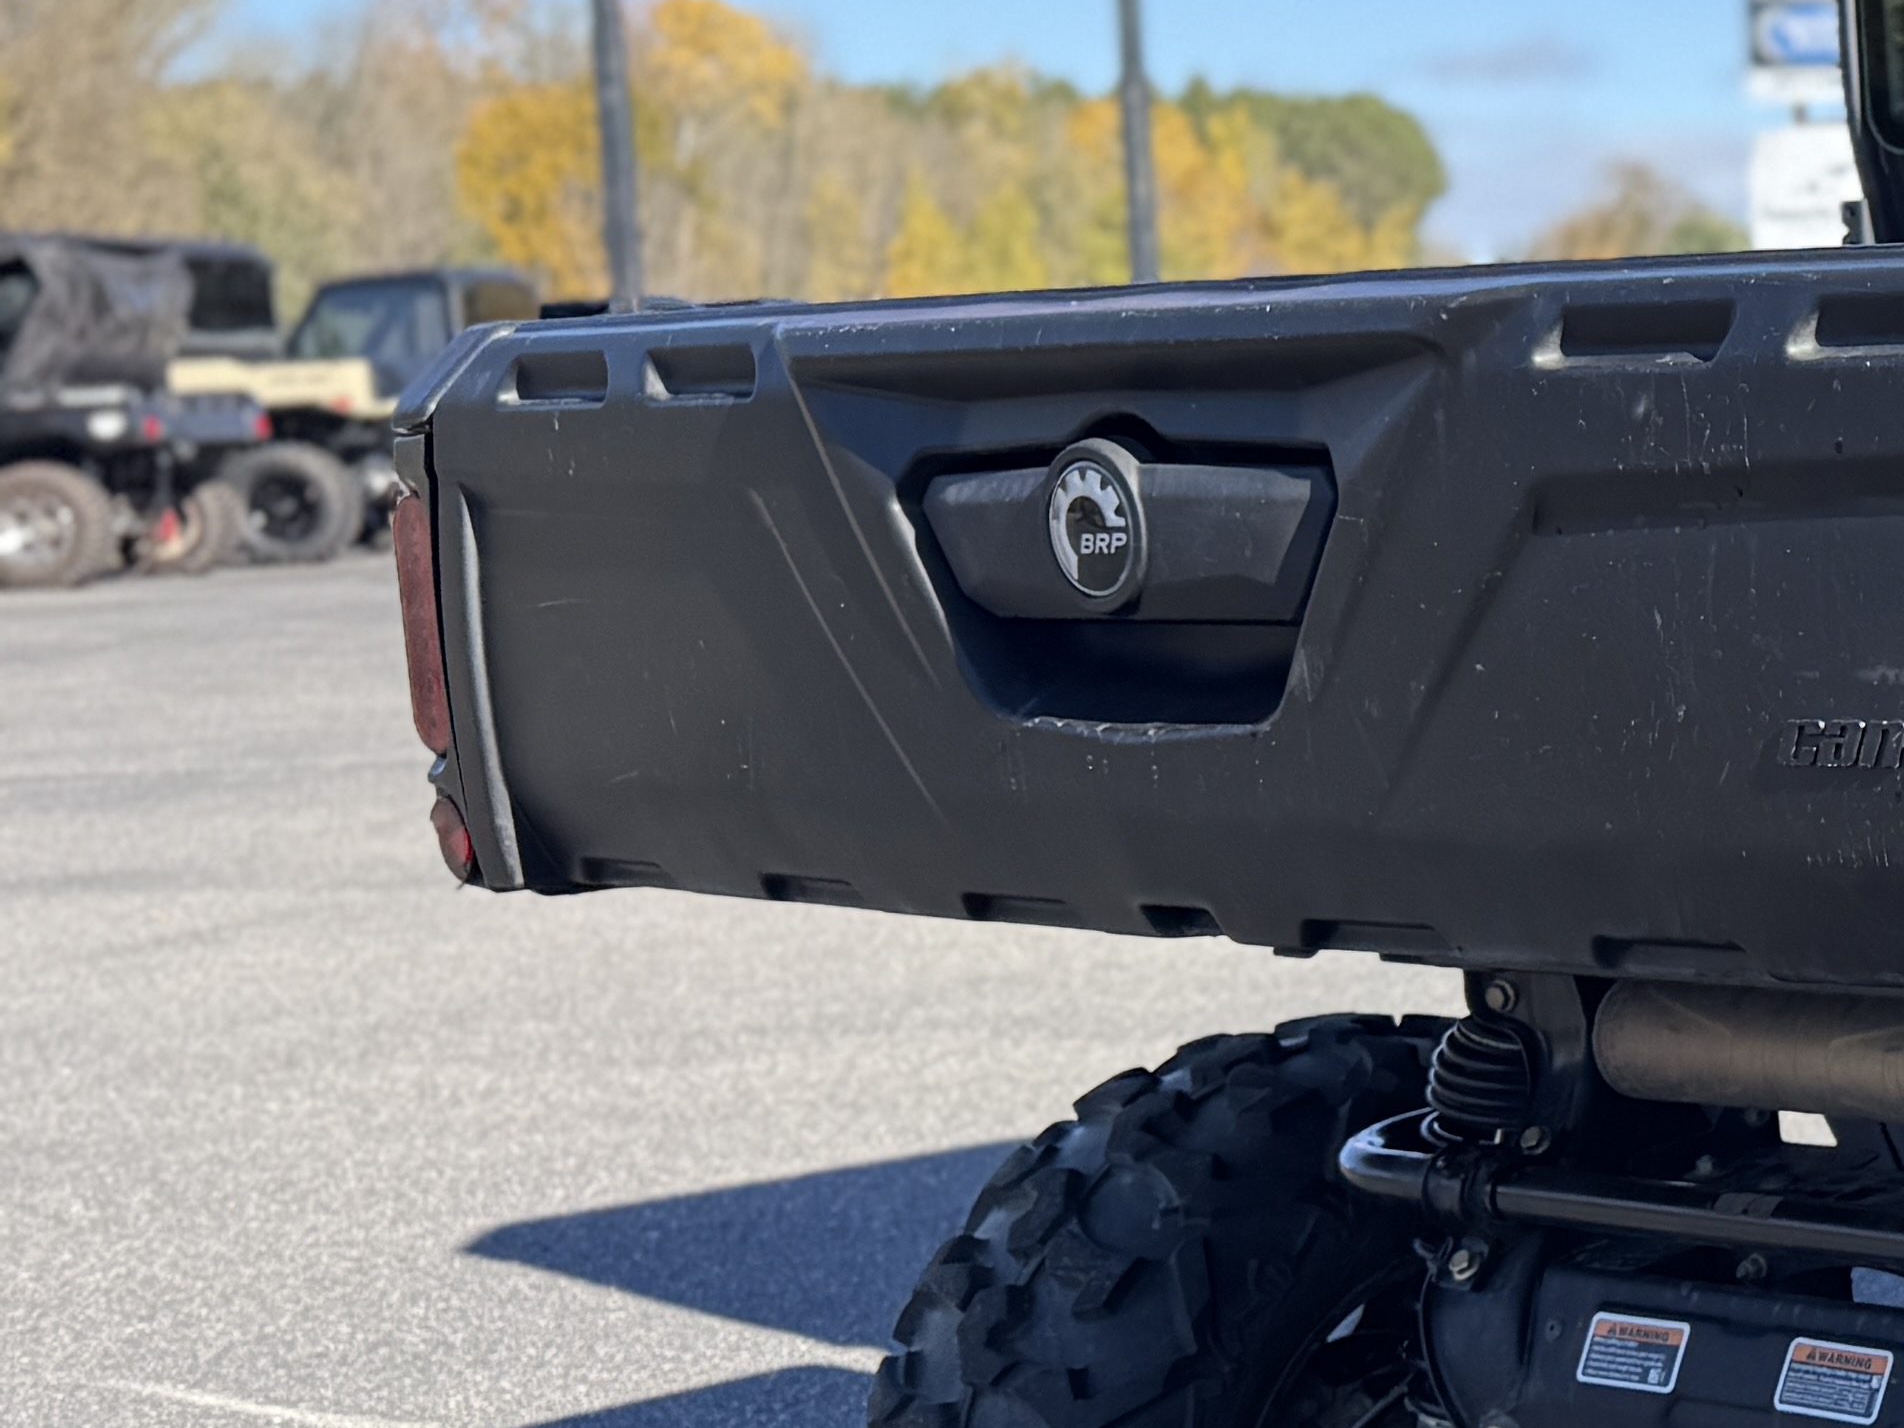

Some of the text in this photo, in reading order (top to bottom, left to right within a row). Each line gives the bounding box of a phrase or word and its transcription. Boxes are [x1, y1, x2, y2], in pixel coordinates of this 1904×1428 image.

[1081, 533, 1127, 554] BRP
[1617, 1325, 1670, 1342] WARNING
[1818, 1350, 1873, 1370] WARNING
